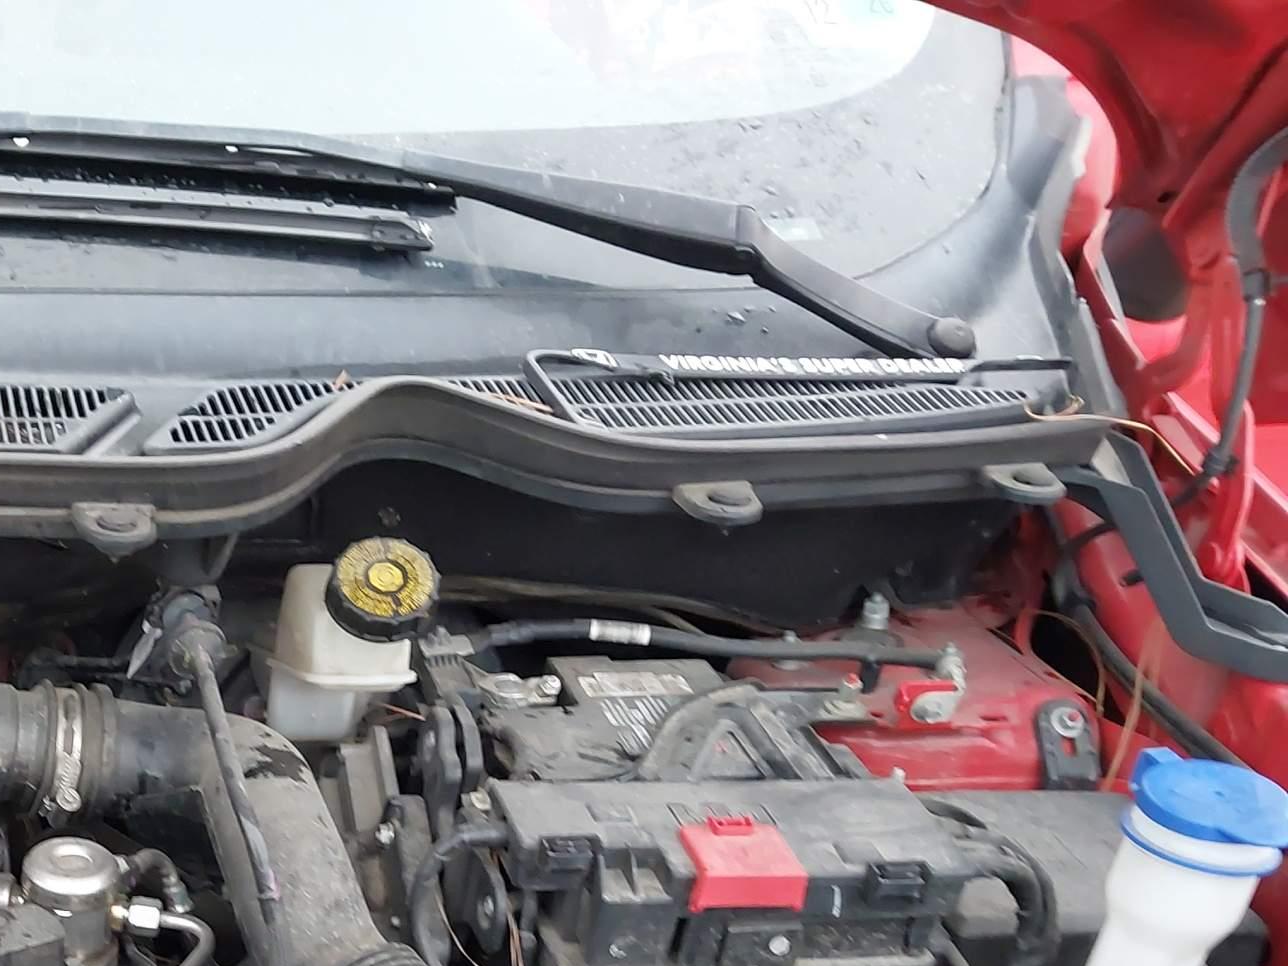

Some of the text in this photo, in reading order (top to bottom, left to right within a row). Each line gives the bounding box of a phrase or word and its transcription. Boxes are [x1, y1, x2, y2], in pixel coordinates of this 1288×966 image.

[658, 354, 967, 374] VIRGINIA'S SUPER DEALER
